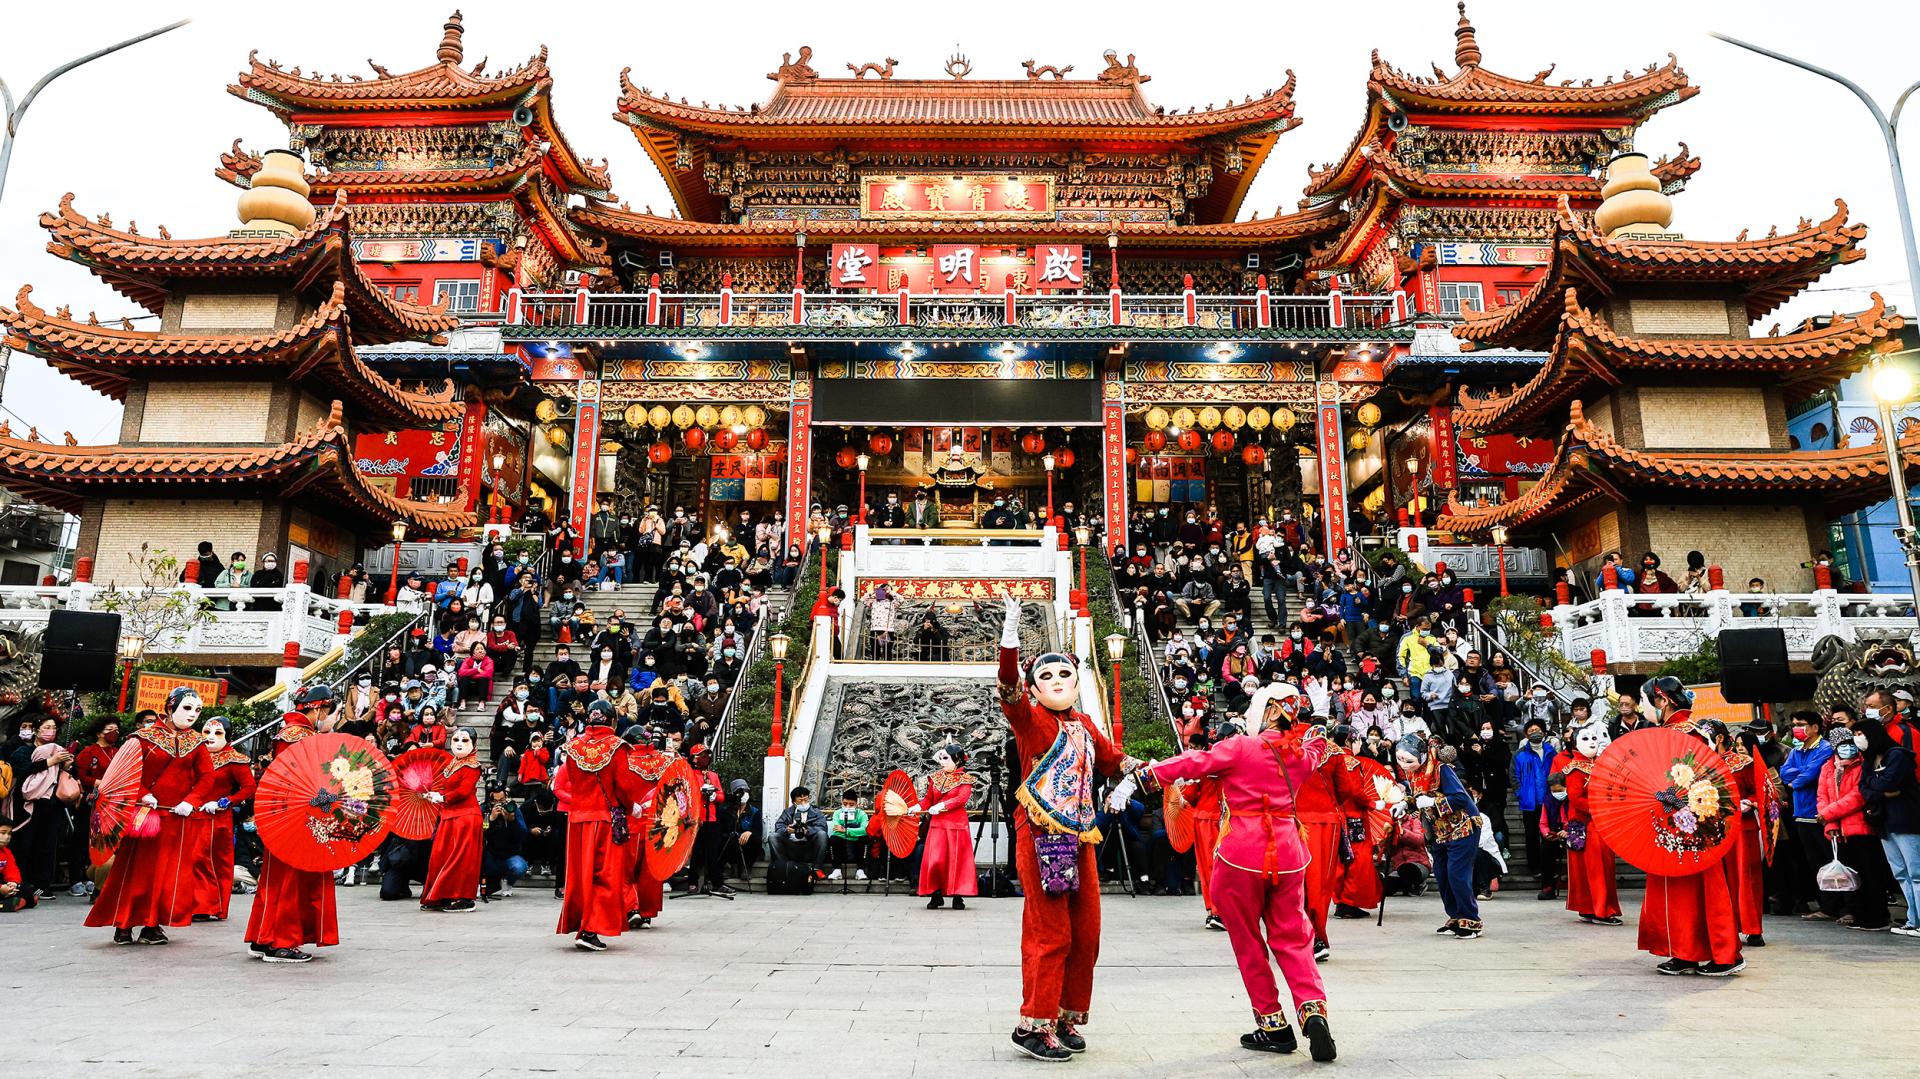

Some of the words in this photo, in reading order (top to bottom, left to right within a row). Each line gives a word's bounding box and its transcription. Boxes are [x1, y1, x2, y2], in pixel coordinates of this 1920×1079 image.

[879, 183, 1035, 211] 凌霄寶殿
[836, 246, 1082, 284] 啟明堂
[139, 690, 167, 700] Welcome
[138, 700, 159, 710] Please
